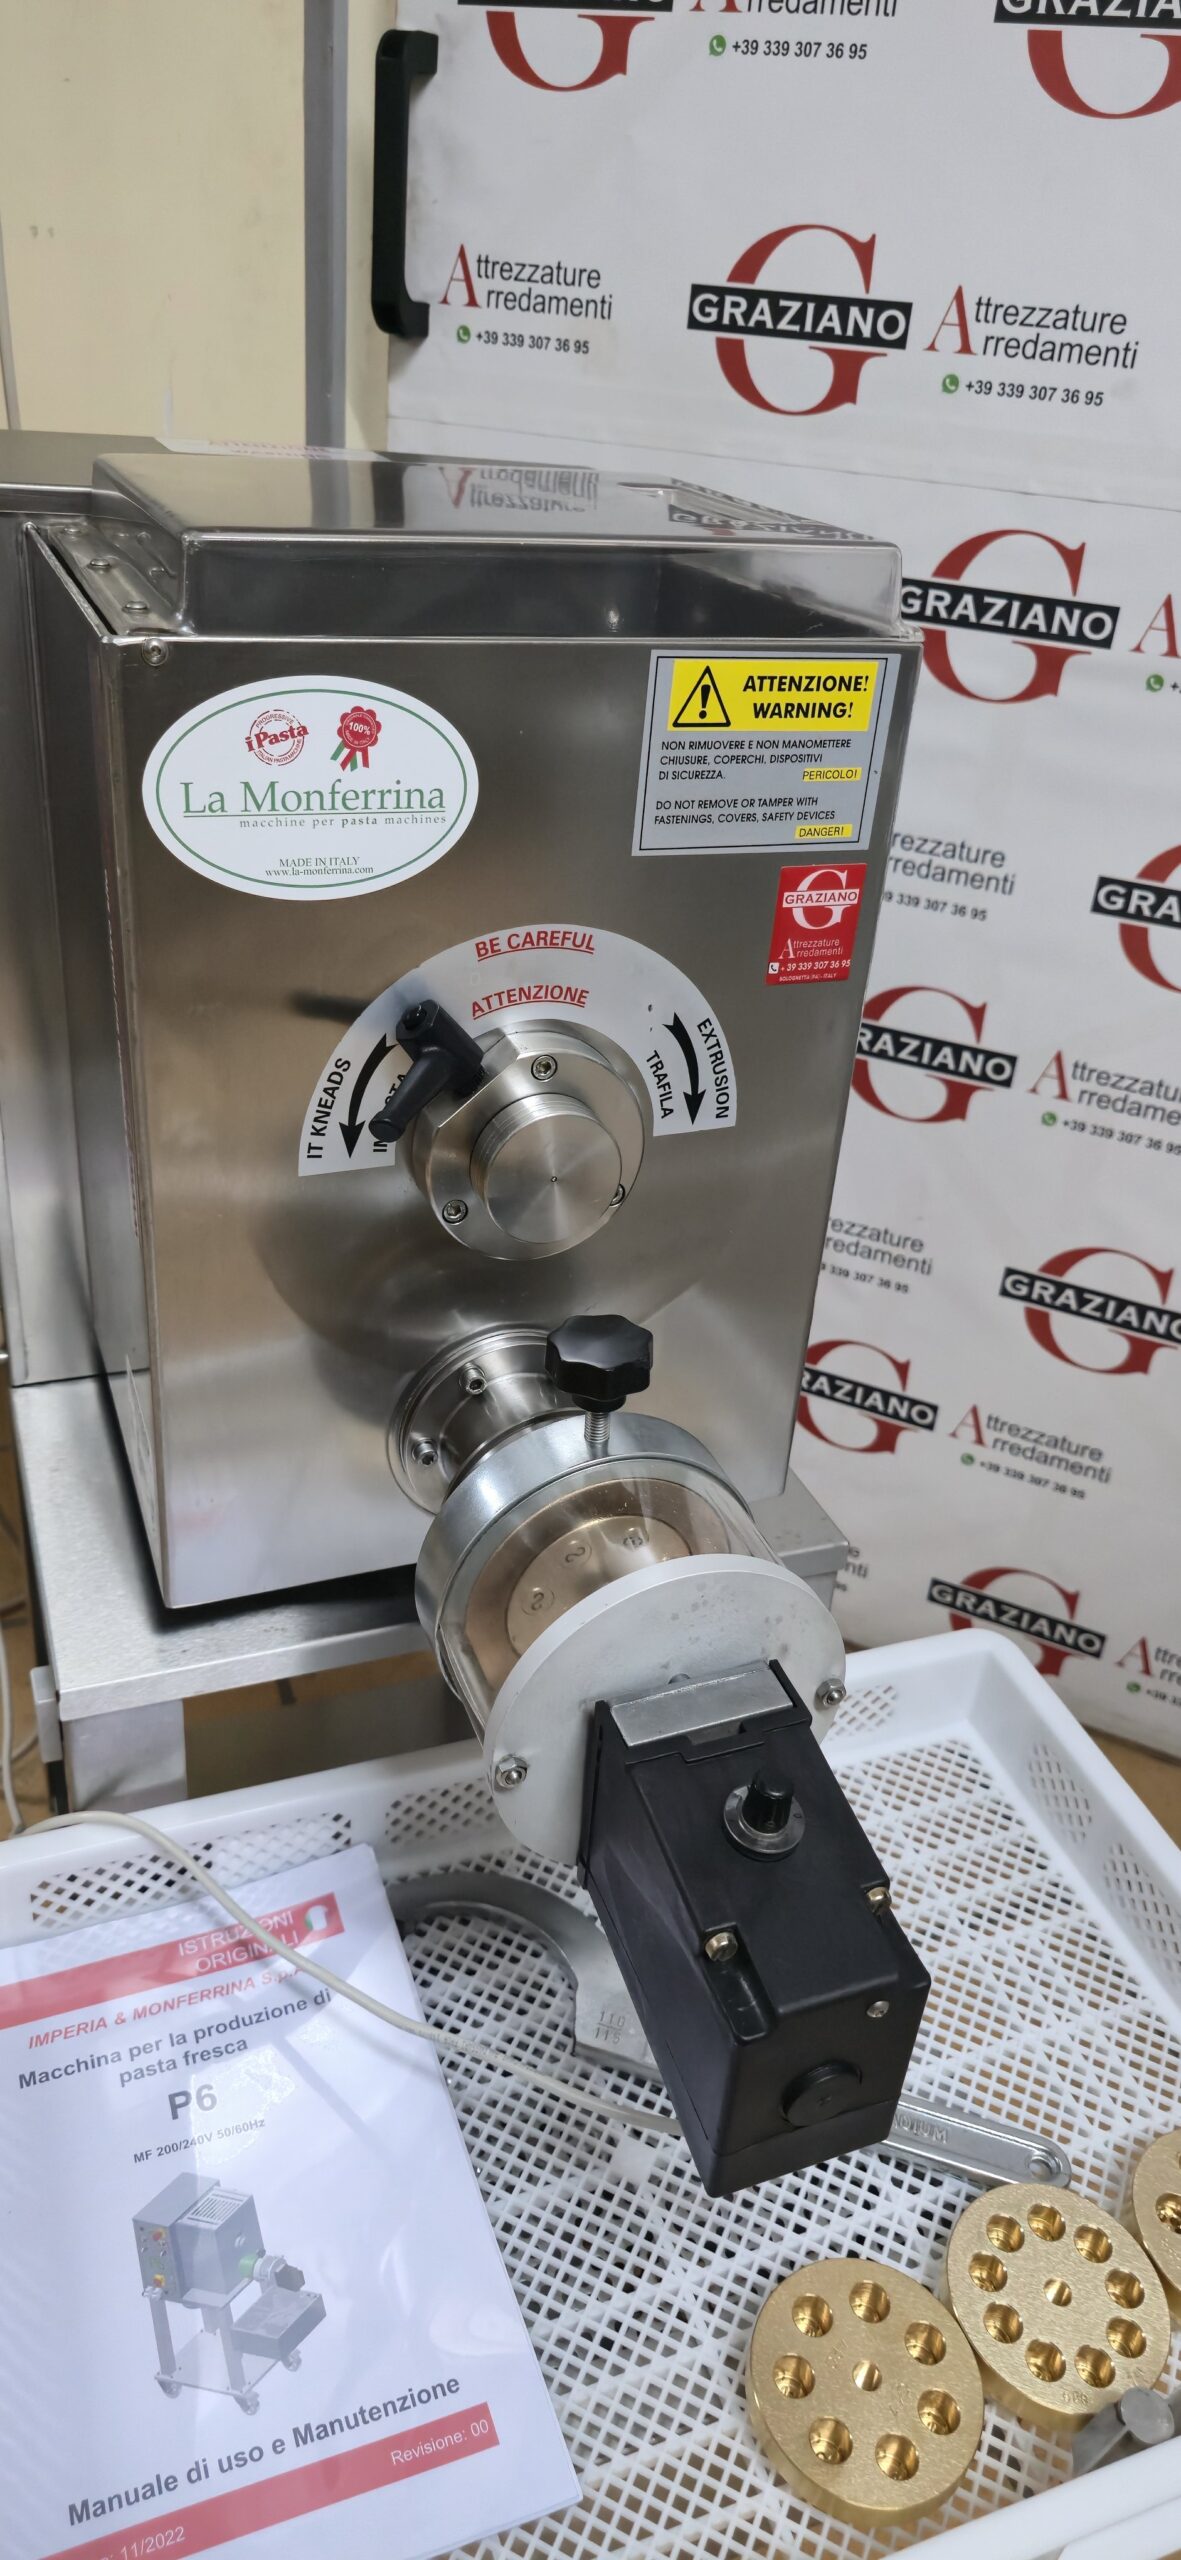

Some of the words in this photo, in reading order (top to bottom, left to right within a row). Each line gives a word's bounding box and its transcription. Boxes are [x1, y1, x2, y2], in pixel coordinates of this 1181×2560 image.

[732, 40, 759, 56] +39
[763, 40, 790, 57] 339
[794, 41, 822, 58] 307
[826, 43, 844, 59] 36
[849, 43, 868, 60] 95
[692, 293, 907, 342] GRAZIANO
[476, 331, 498, 345] +39
[502, 332, 525, 348] 339
[528, 335, 551, 351] 307
[555, 338, 570, 353] 36
[573, 339, 590, 355] 95
[965, 380, 992, 396] +39
[997, 382, 1025, 399] 339
[1029, 385, 1057, 402] 307
[1061, 388, 1080, 404] 36
[1084, 391, 1104, 407] 95
[901, 585, 1114, 641] GRAZIANO
[742, 674, 869, 693] ATTENZIONE!
[752, 702, 854, 719] WARNING!
[254, 725, 309, 749] Pasta
[349, 721, 371, 736] 100%
[661, 741, 685, 751] NON
[688, 740, 745, 751] RIMUOVERE
[748, 740, 753, 750] E
[756, 740, 779, 750] NON
[781, 739, 852, 749] MANOMETTERE
[660, 755, 711, 766] CHIUSURE,
[714, 754, 766, 765] COPERCHI,
[769, 753, 823, 764] DISPOSITIVI
[659, 770, 669, 780] DI
[671, 769, 726, 780] SICUREZZA.
[802, 769, 858, 781] PERICOLO!
[180, 781, 228, 814] La
[240, 778, 446, 813] Monferrina
[656, 800, 671, 810] DO
[674, 799, 695, 810] NOT
[697, 798, 738, 809] REMOVE
[740, 798, 755, 808] OR
[758, 797, 794, 807] TAMPER
[796, 796, 818, 807] WITH
[239, 816, 306, 829] macchine
[312, 818, 335, 830] per
[341, 815, 378, 828] pasta
[384, 814, 447, 826] machines
[654, 813, 715, 825] FASTENINGS,
[717, 812, 759, 824] COVERS,
[761, 811, 794, 822] SAFETY
[796, 810, 836, 821] DEVICES
[799, 827, 845, 838] DANGER!
[265, 866, 374, 877] www.la-monferrina.com
[279, 857, 312, 868] MADE
[315, 857, 327, 867] IN
[328, 856, 360, 867] ITALY
[785, 891, 858, 905] GRAZIANO
[475, 937, 501, 958] BE
[507, 930, 595, 951] CAREFUL
[472, 985, 590, 1017] ATTENZIONE
[696, 1017, 730, 1119] EXTRUSION
[310, 1058, 351, 1136] KNEADS
[646, 1049, 674, 1119] TRAFILA
[307, 1142, 323, 1159] IT
[930, 1583, 1100, 1652] GRAZIANO
[178, 1910, 294, 1956] ISTRUZONI
[196, 1931, 300, 1972] ORIGINLI
[29, 2017, 107, 2049] IMPERIA
[114, 2011, 126, 2026] &
[132, 1976, 255, 2020] MONFERRINA
[18, 2050, 122, 2089] Macchina
[129, 2038, 163, 2062] per
[169, 2032, 187, 2048] la
[193, 1999, 307, 2044] produzione
[313, 1988, 332, 2006] di
[119, 2057, 178, 2087] pasta
[183, 2038, 248, 2067] fresca
[168, 2084, 217, 2120] P6
[133, 2150, 153, 2164] MF
[156, 2132, 213, 2158] 200/240V
[217, 2119, 266, 2140] 50/60Hz
[68, 2473, 179, 2526] Manuale
[186, 2458, 210, 2485] di
[217, 2444, 264, 2475] uso
[272, 2438, 286, 2455] e
[292, 2376, 461, 2448] Manutenzione
[390, 2429, 468, 2467] Revisione:
[470, 2418, 490, 2438] 00
[120, 2526, 186, 2560] 11/2022
